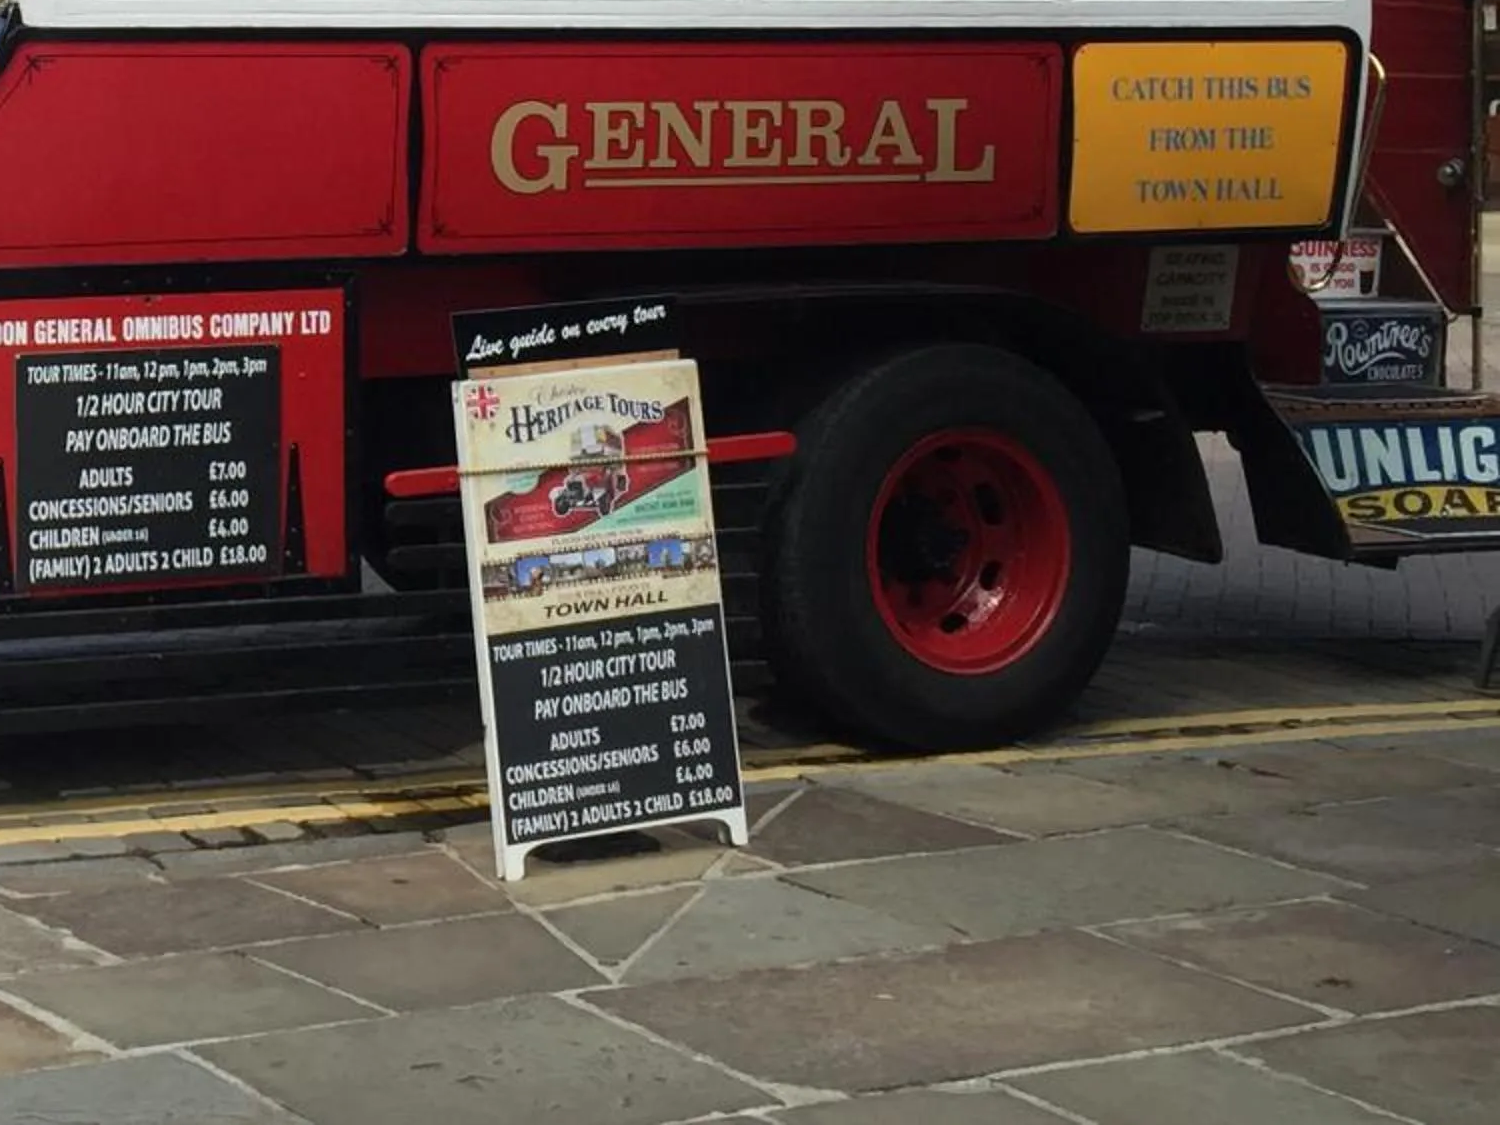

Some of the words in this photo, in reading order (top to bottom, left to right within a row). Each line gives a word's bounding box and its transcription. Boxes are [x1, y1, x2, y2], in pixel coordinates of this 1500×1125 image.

[1112, 77, 1194, 101] CATCH
[1204, 77, 1258, 99] THIS
[1267, 76, 1311, 98] BUS
[491, 98, 995, 195] GENERAL
[1149, 128, 1216, 152] FROM
[1225, 127, 1275, 150] THE
[1137, 179, 1207, 203] TOWN
[1216, 178, 1283, 201] HALL
[34, 318, 116, 344] GENERAL
[122, 315, 203, 342] OMNIBUS
[210, 312, 294, 338] COMPANY
[300, 310, 331, 336] LTD
[466, 334, 504, 361] Live
[510, 324, 555, 358] guide
[561, 325, 580, 340] on
[586, 313, 628, 336] every
[633, 304, 667, 325] tour
[1324, 321, 1432, 375] Rowntree's
[27, 365, 59, 384] TOUR
[62, 364, 97, 383] TIMES
[242, 356, 267, 376] 3pm
[77, 394, 99, 417] 1/2
[102, 392, 144, 416] HOUR
[148, 390, 180, 413] CITY
[183, 388, 222, 410] TOUR
[505, 394, 604, 443] HERITAGE
[608, 392, 663, 420] TOURS
[65, 428, 94, 453] PAY
[97, 425, 171, 451] ONBOARD
[173, 423, 201, 446] THE
[203, 421, 231, 444] BUS
[79, 466, 133, 489] ADULTS
[209, 461, 246, 482] £7.00
[29, 491, 193, 521] CONCESSIONS/SENIORS
[210, 489, 249, 508] £6.00
[29, 527, 99, 551] CHILDREN
[209, 518, 249, 538] £4.00
[29, 554, 90, 583] (FAMILY)
[93, 556, 102, 575] 2
[104, 551, 158, 573] ADULTS
[162, 552, 170, 569] 2
[173, 547, 213, 568] CHILD
[220, 545, 267, 565] £18.00
[544, 598, 609, 619] TOWN
[615, 589, 668, 609] HALL
[493, 643, 524, 663] TOUR
[525, 638, 557, 659] TIMES
[691, 618, 714, 637] 3pm
[541, 667, 562, 688] 1/2
[564, 660, 604, 684] HOUR
[606, 654, 636, 677] CITY
[640, 648, 676, 671] TOUR
[535, 697, 560, 721] PAY
[562, 687, 631, 716] ONBOARD
[633, 682, 659, 706] THE
[662, 678, 688, 700] BUS
[550, 727, 600, 752] ADULTS
[671, 712, 705, 733] £7.00
[506, 744, 659, 786] CONCESSIONS/SENIORS
[674, 737, 711, 759] £6.00
[509, 784, 575, 811] CHILDREN
[676, 762, 713, 784] £4.00
[512, 811, 568, 841] (FAMILY)
[582, 800, 632, 826] ADULTS
[644, 792, 683, 815] CHILD
[688, 786, 733, 809] £18.00
